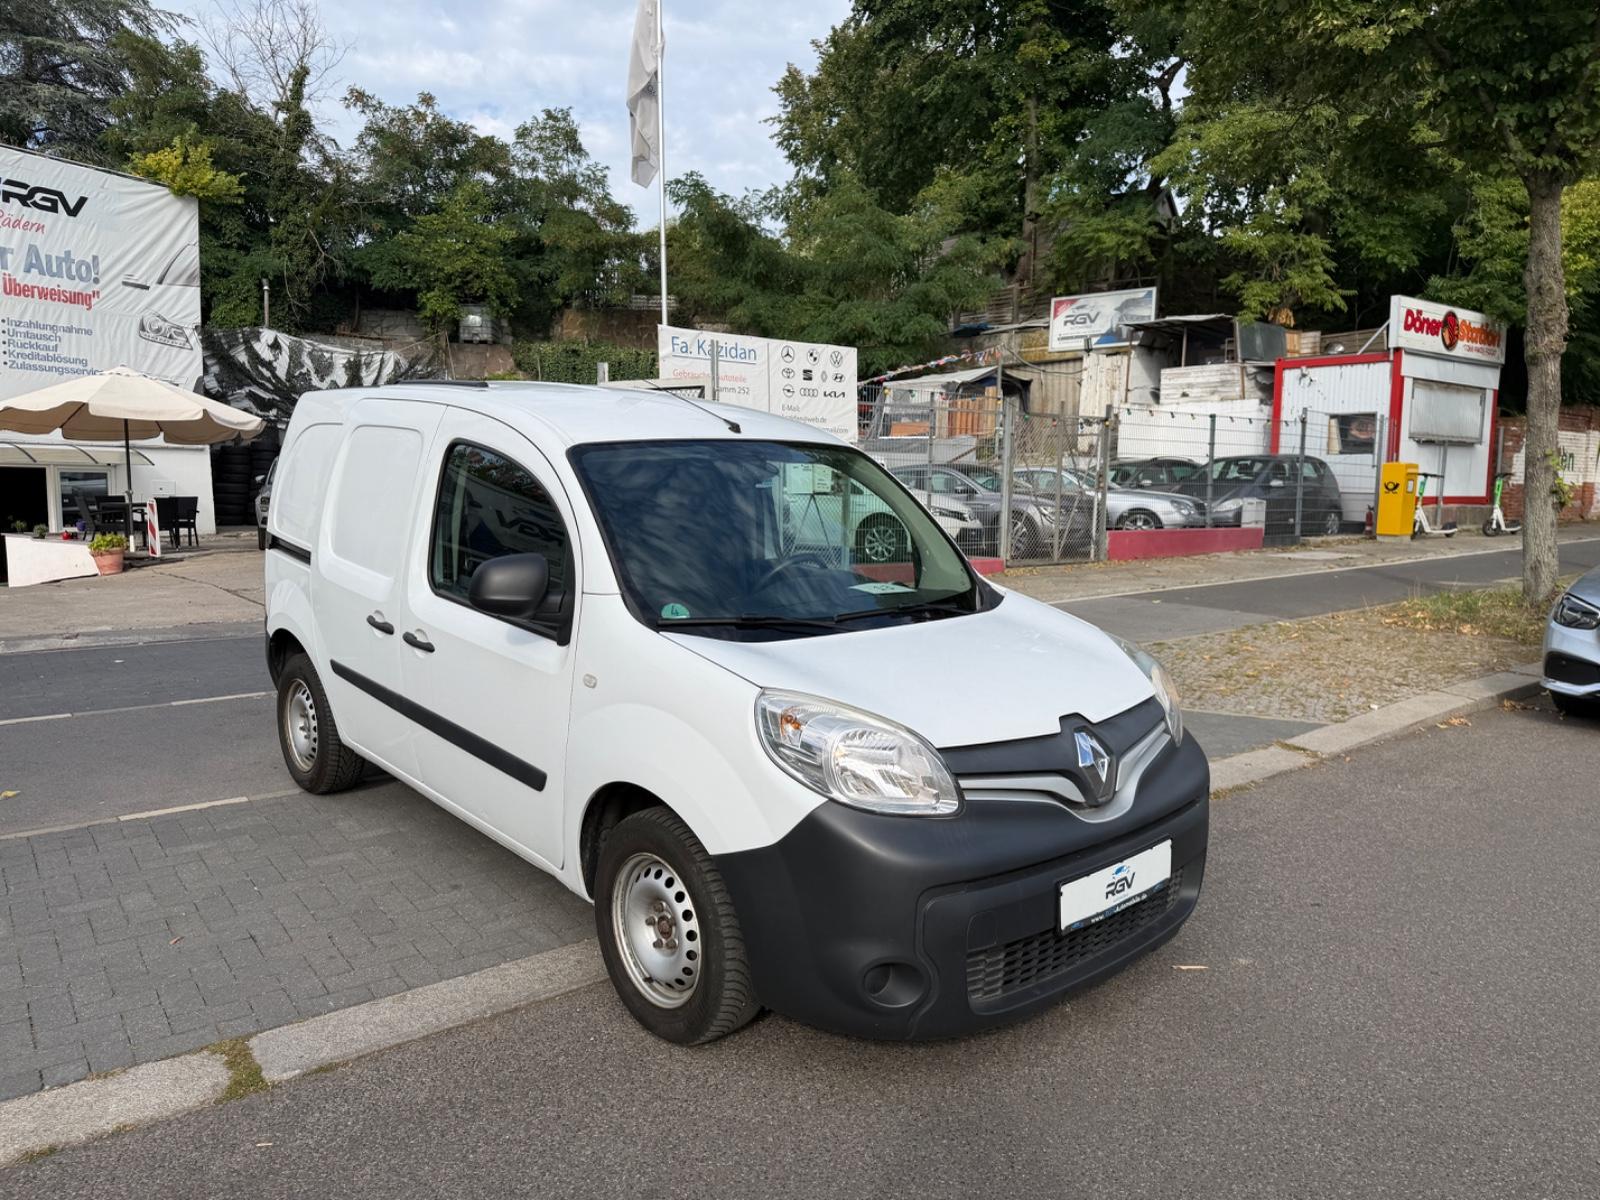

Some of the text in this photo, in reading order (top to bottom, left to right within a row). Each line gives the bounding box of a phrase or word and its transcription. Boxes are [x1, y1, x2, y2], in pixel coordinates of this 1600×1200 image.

[2, 178, 88, 217] RGV
[24, 243, 100, 285] Auto!
[3, 272, 100, 311] Überweisung"
[1064, 311, 1101, 327] RGV
[1404, 308, 1443, 337] Döner
[7, 328, 61, 343] Umtausch
[671, 335, 692, 355] Fa.
[1105, 871, 1136, 900] RGV
